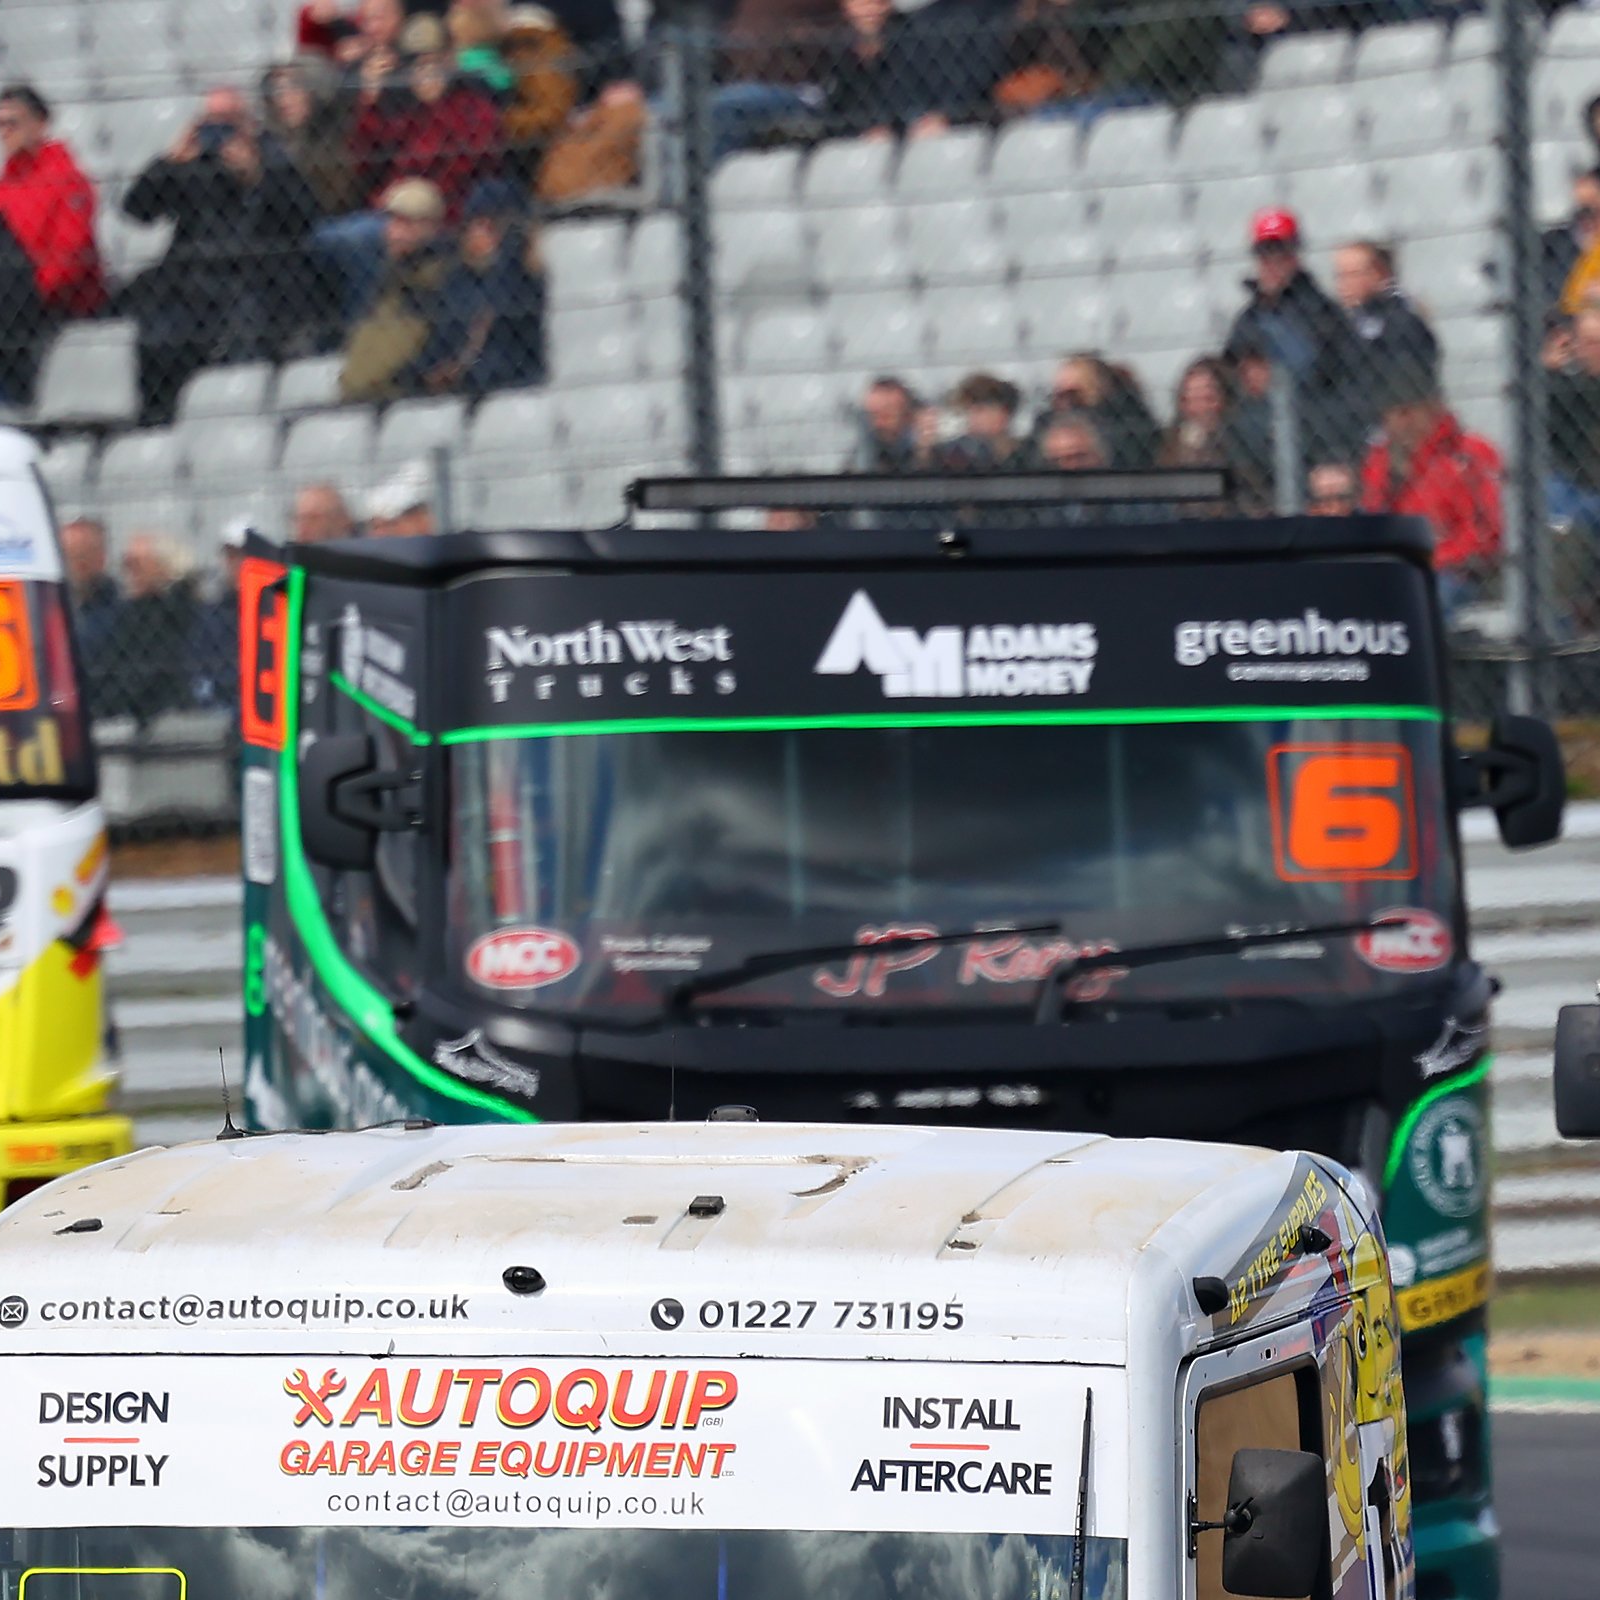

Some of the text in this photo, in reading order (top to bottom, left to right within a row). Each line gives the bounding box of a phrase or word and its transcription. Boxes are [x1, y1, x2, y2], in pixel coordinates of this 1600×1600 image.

[965, 622, 1099, 660] ADAMS
[1174, 607, 1410, 667] greenhous
[484, 665, 738, 702] Trucks
[966, 660, 1095, 697] MOREY
[1288, 756, 1400, 870] 6
[1248, 1236, 1281, 1297] TYRE
[1278, 1168, 1328, 1260] SUPPLIES
[39, 1293, 470, 1327] contact@autoquip.co.uk
[698, 1299, 966, 1331] 01227 731195
[38, 1391, 170, 1425] DESIGN
[339, 1367, 740, 1434] AUTOQUIP
[882, 1396, 1022, 1432] INSTALL
[36, 1454, 170, 1488] SUPPLY
[278, 1440, 462, 1477] GARAGE
[468, 1440, 738, 1479] EQUIPMENT
[849, 1459, 1053, 1496] AFTERCARE
[326, 1488, 706, 1519] contact@autoquip.co.uk
